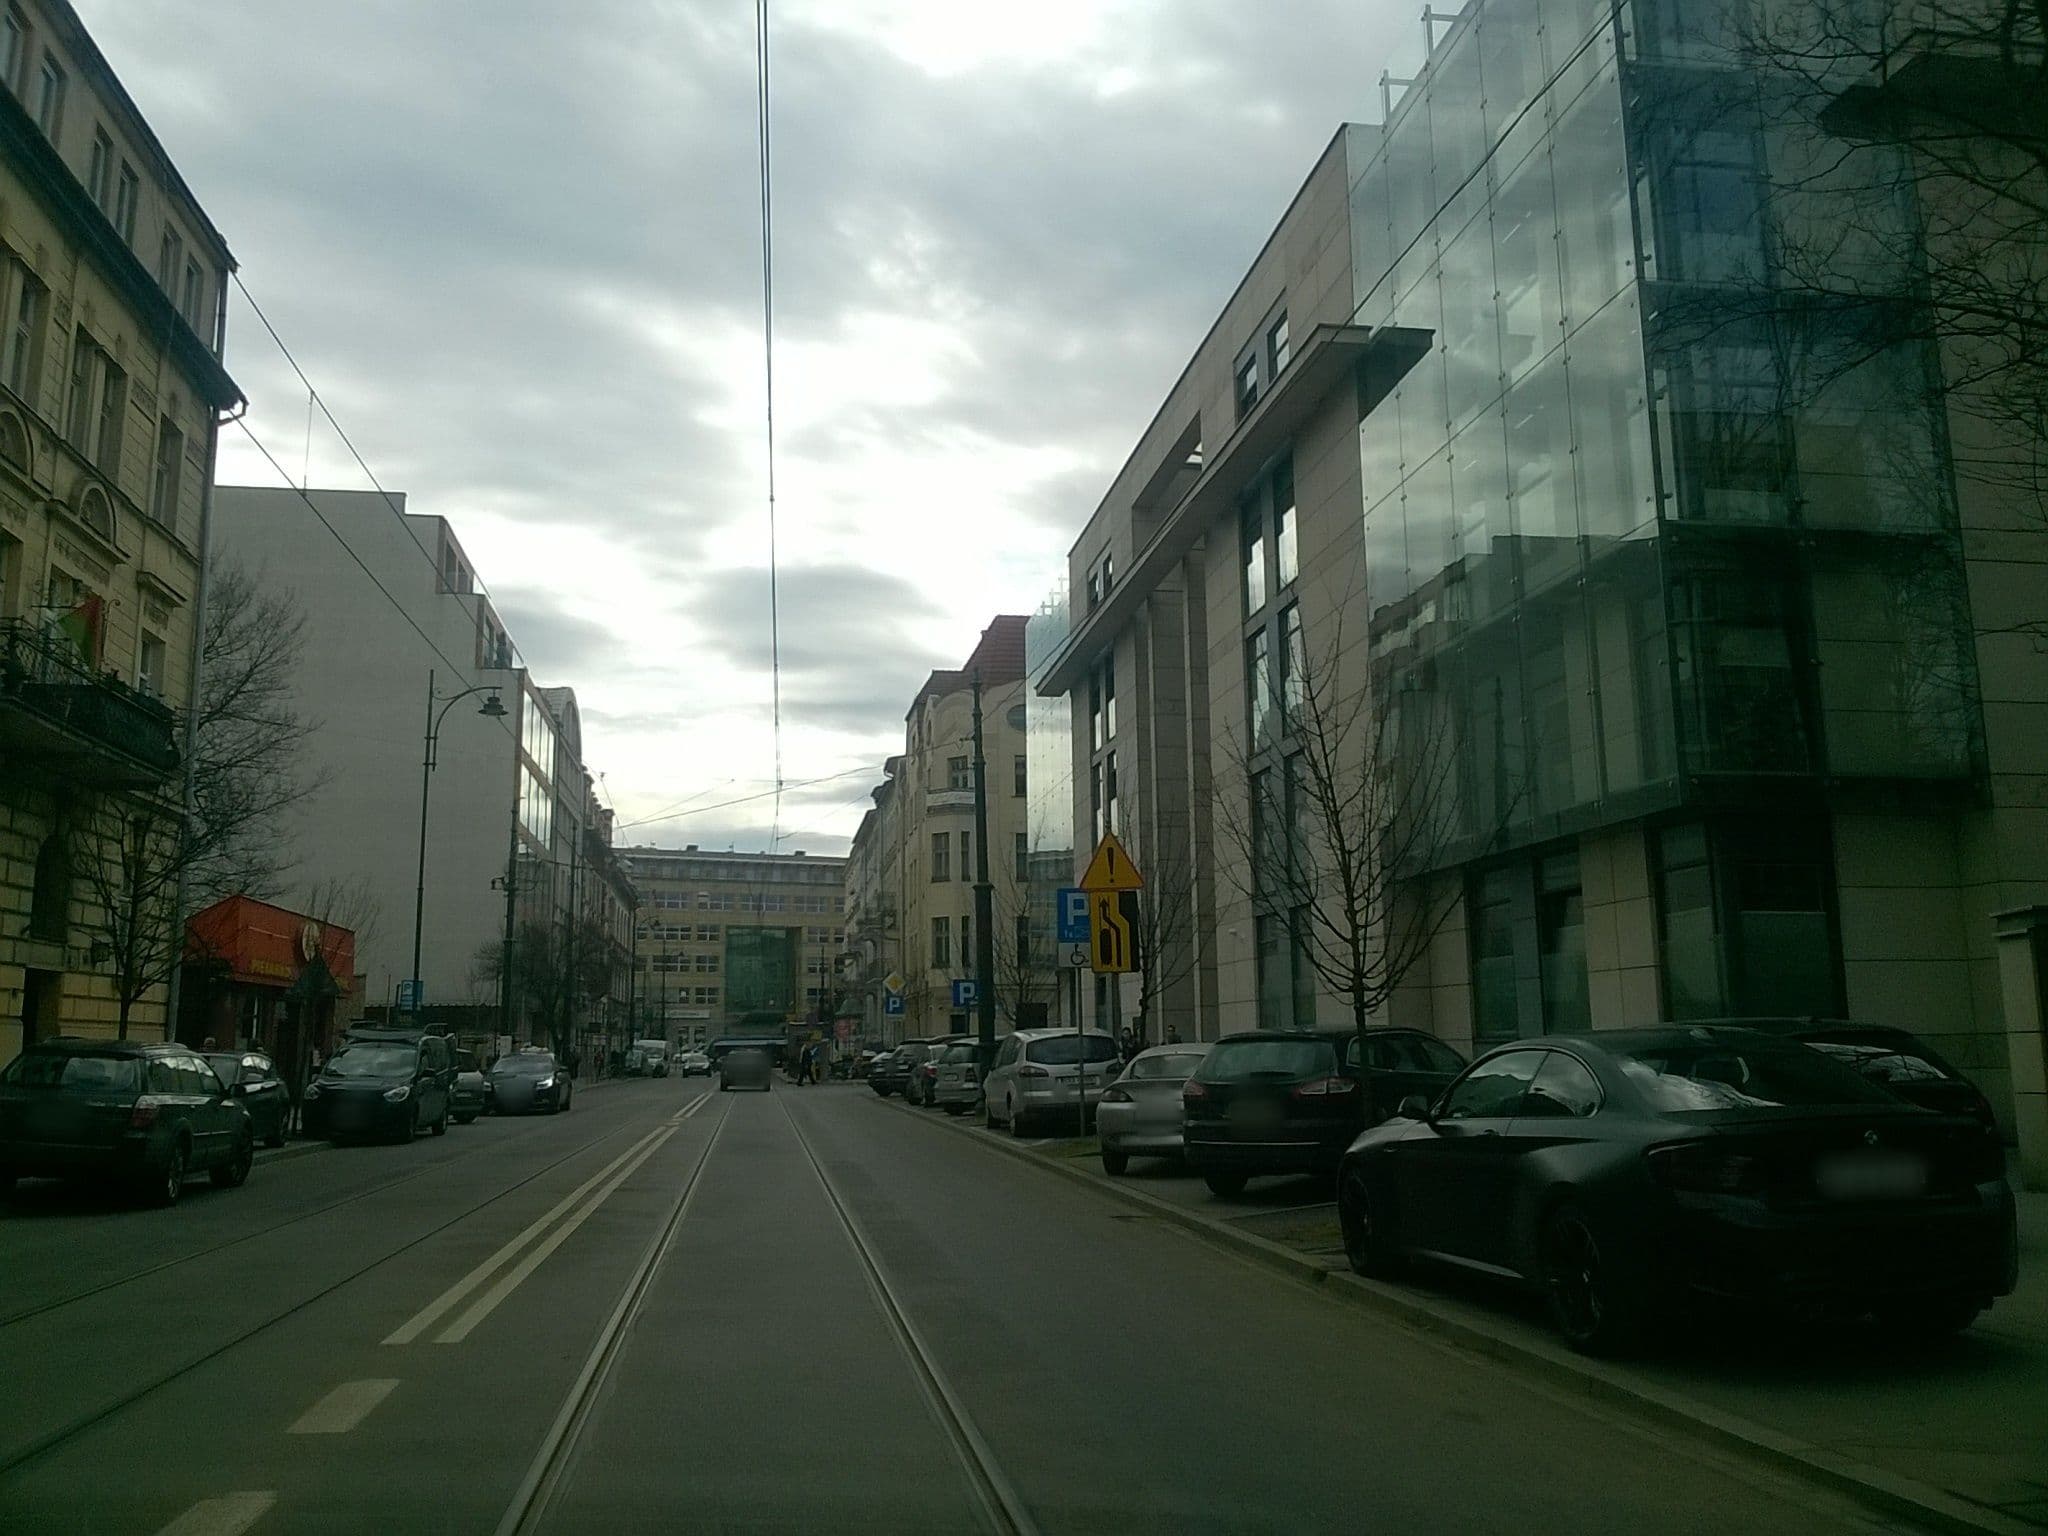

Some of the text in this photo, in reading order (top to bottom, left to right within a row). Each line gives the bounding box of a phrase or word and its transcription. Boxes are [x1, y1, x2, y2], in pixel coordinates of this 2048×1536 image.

[1067, 891, 1090, 926] P
[960, 982, 975, 1004] P
[889, 997, 900, 1012] P
